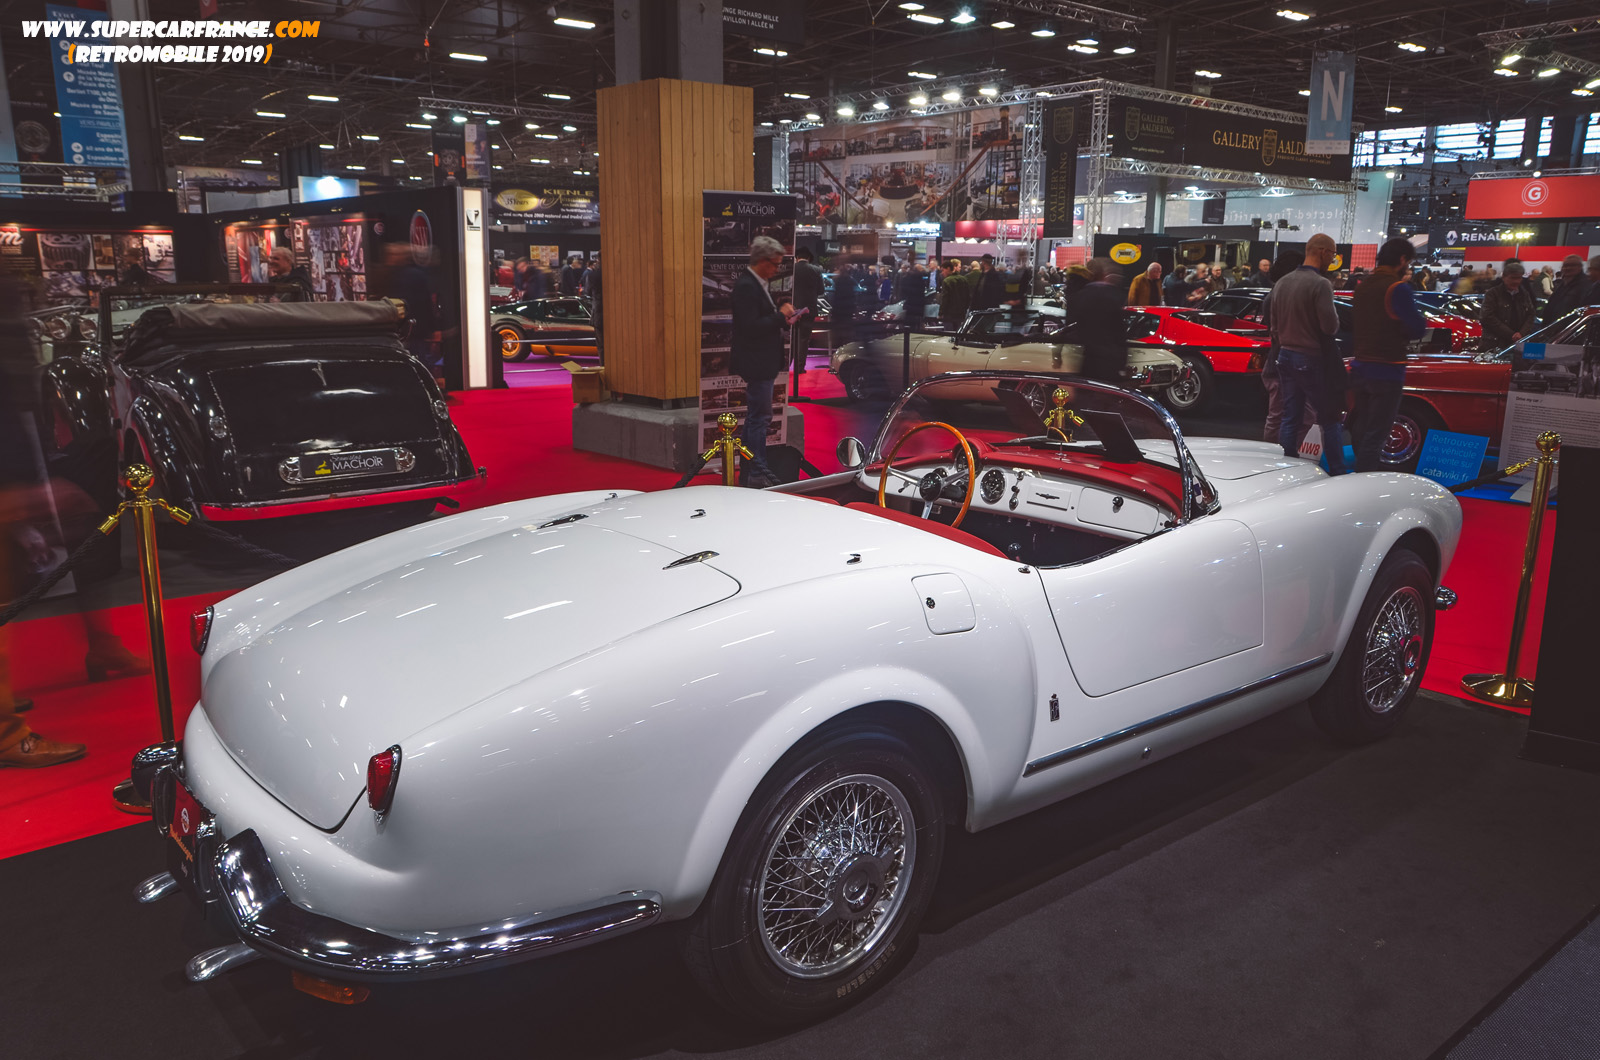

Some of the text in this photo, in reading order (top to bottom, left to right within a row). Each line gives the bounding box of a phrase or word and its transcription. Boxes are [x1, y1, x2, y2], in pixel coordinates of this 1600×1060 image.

[722, 15, 747, 25] AVILLON
[768, 22, 774, 30] M
[738, 8, 762, 19] RICHARD
[763, 13, 779, 23] MILLE
[1321, 69, 1346, 121] N
[1141, 112, 1169, 125] GALLERY
[1141, 122, 1175, 135] AALDERING
[1212, 129, 1262, 151] GALLERY
[543, 188, 595, 197] KIENLE
[1057, 151, 1068, 222] AALDERING
[1528, 187, 1542, 201] G
[1050, 168, 1059, 223] GALLERY
[1431, 434, 1479, 449] Retrouvez
[1429, 445, 1477, 459] ce véhicule
[1439, 458, 1460, 466] vente
[1461, 461, 1473, 469] sur
[1422, 467, 1469, 483] catawiki.fr
